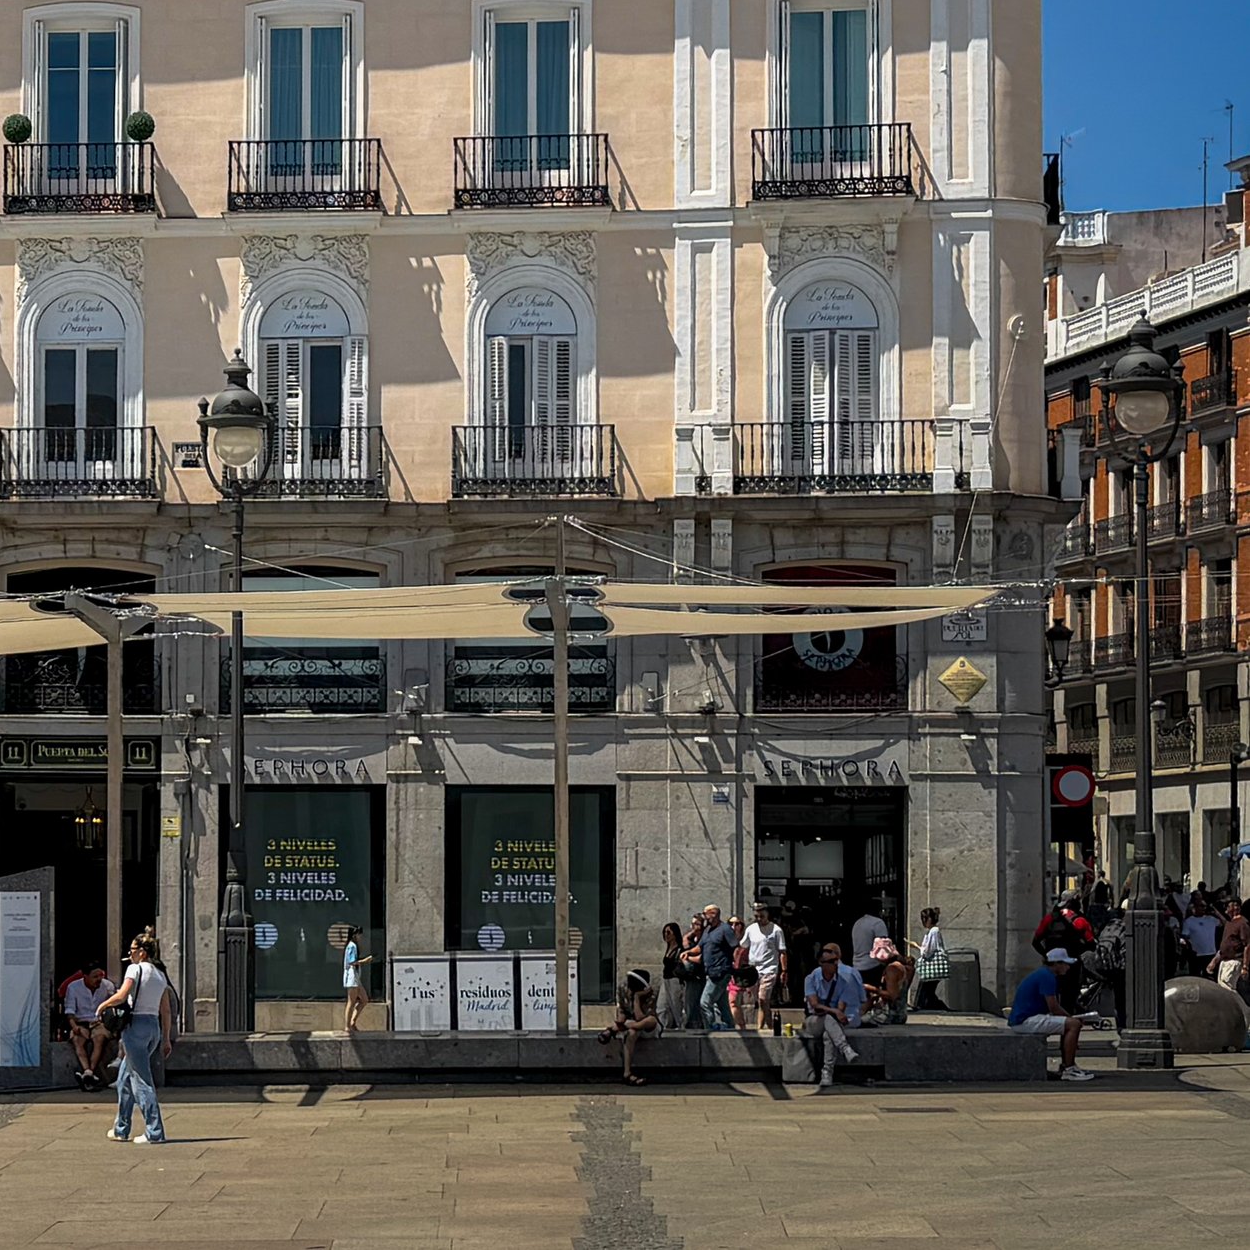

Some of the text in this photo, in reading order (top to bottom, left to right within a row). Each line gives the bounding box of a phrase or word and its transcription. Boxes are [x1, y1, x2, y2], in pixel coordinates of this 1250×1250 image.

[246, 759, 369, 777] EPHORA
[764, 759, 901, 778] SEPHORA
[267, 838, 336, 850] 3 NIVELES
[494, 840, 557, 852] 3 NIVELE
[264, 855, 340, 867] DE STATUS.
[491, 857, 555, 869] DE STATU
[267, 872, 336, 884] 3 NIVELES
[494, 874, 557, 886] 3 NIVELE
[254, 889, 349, 901] DE FELICIDAD.
[481, 891, 499, 903] DE
[408, 986, 436, 999] Tus
[460, 985, 512, 999] residuos
[466, 1001, 508, 1012] Madrid
